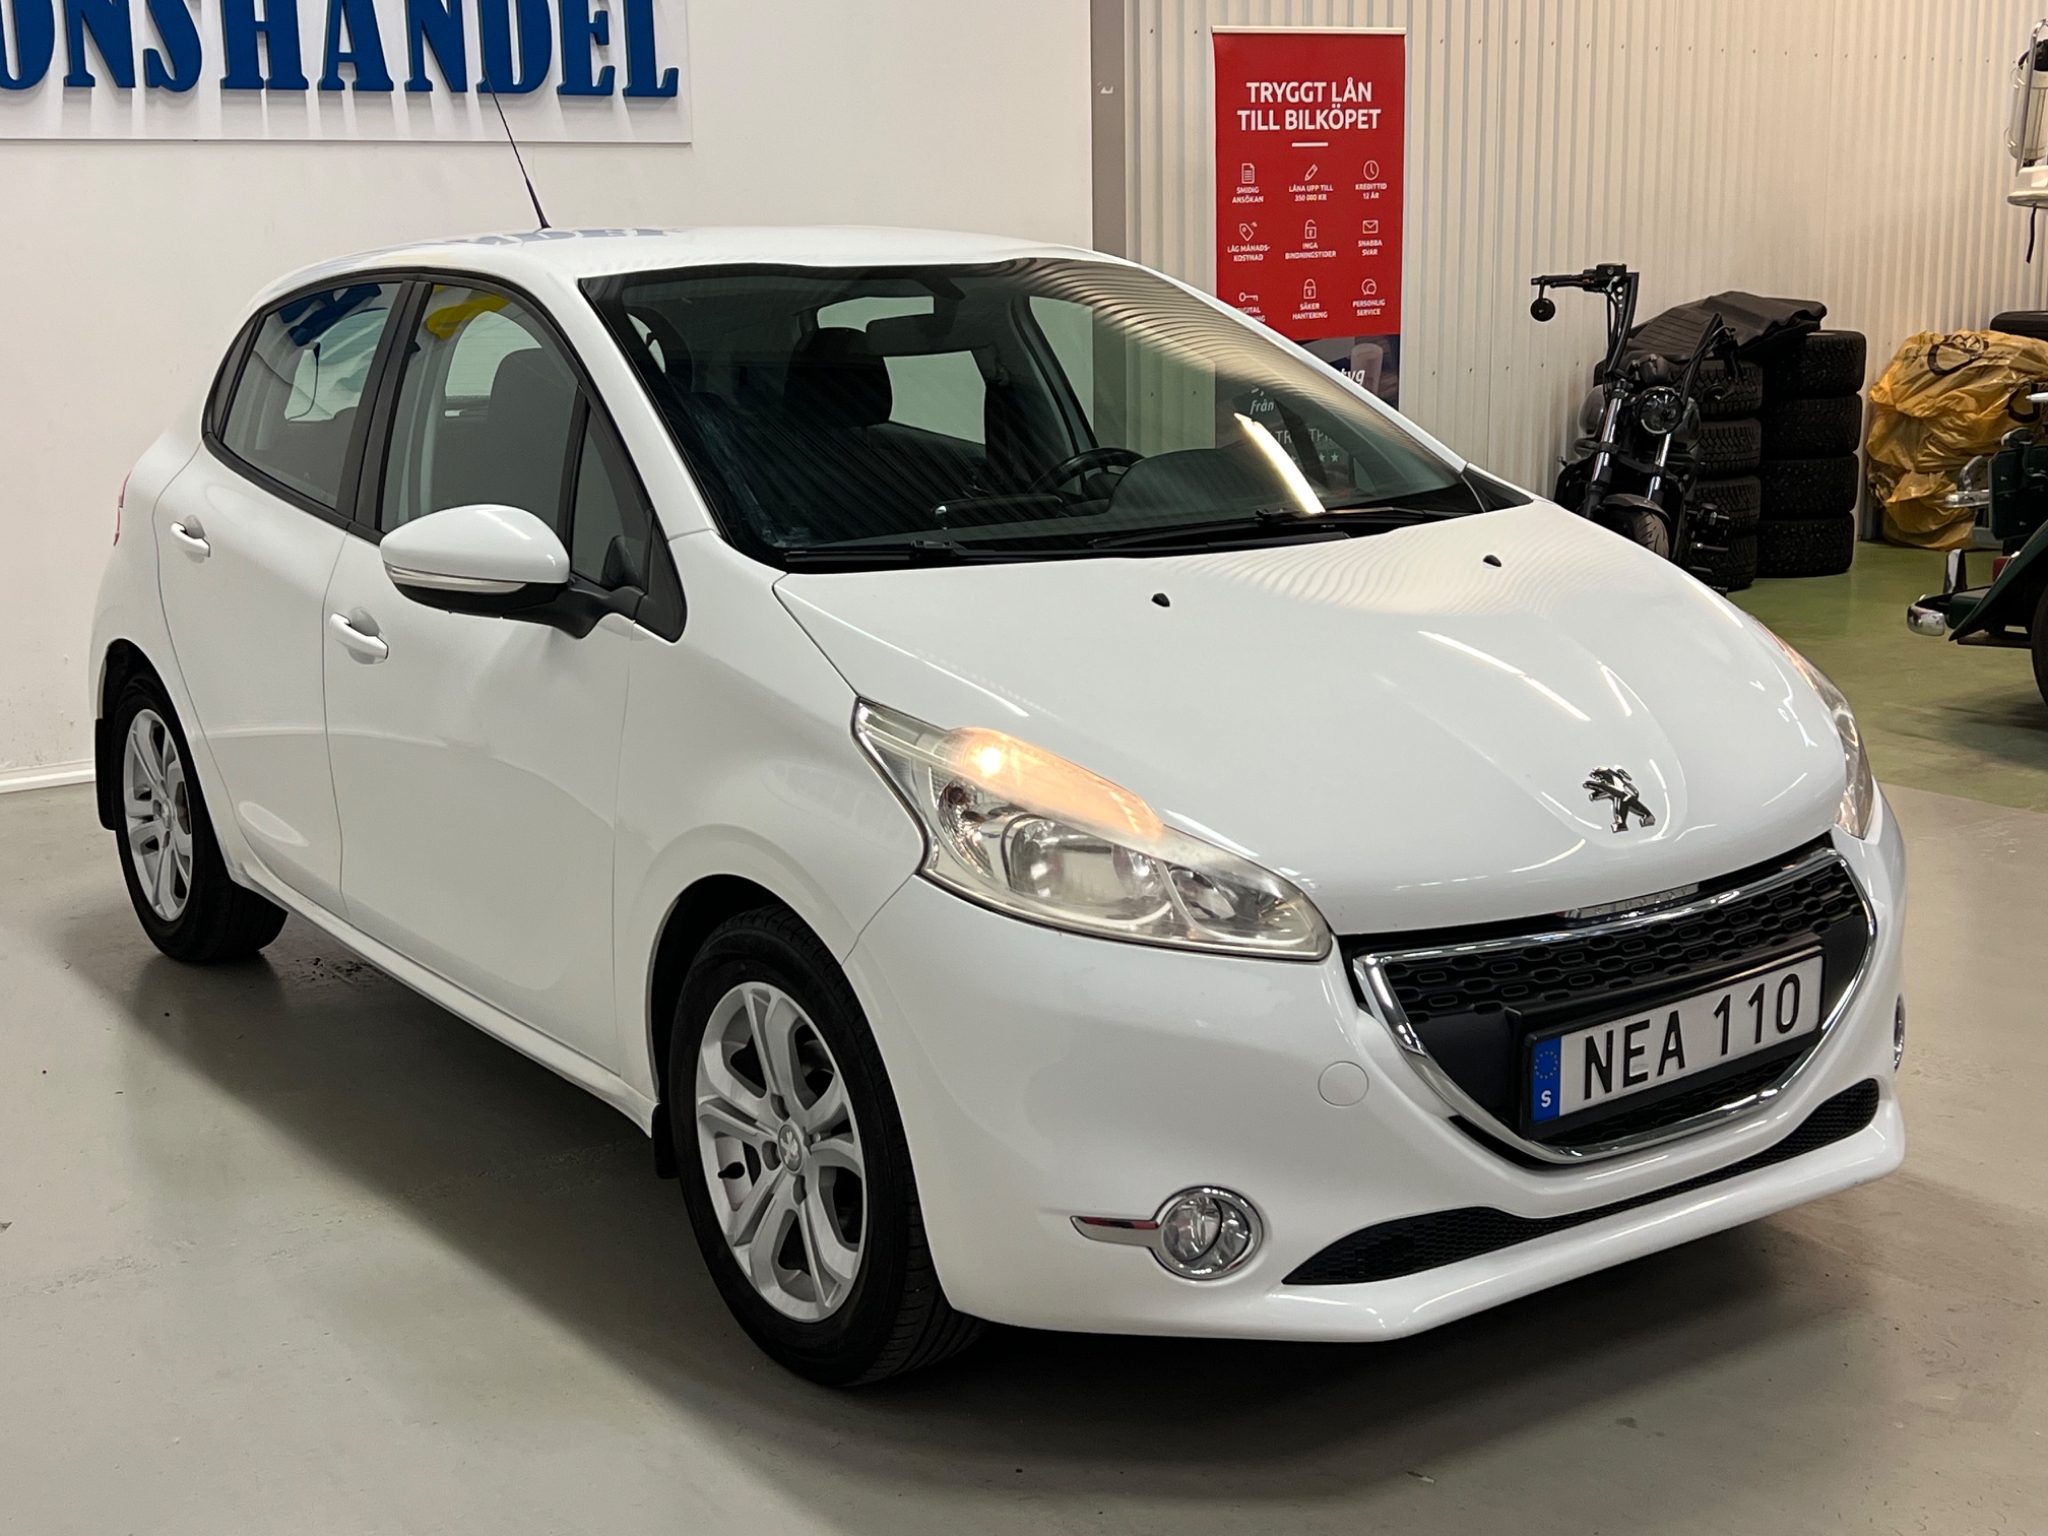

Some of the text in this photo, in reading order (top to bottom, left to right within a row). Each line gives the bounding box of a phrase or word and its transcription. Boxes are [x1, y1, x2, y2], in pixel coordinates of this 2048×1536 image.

[1246, 77, 1372, 103] TRYGGT LÅN
[1237, 103, 1382, 131] TILL BILKÖPET
[1236, 186, 1260, 194] SMIDIG
[1288, 184, 1334, 193] LÅNA UPP TILL
[1355, 182, 1388, 191] KREDITTID
[1232, 194, 1264, 203] ANSÖKAN
[1306, 194, 1318, 202] 000
[1362, 191, 1380, 200] 12 ÅR
[1227, 243, 1271, 253] LÅG MÅNADS-
[1302, 242, 1319, 250] INGA
[1357, 240, 1383, 248] SNABBA
[1284, 250, 1337, 260] BINDNINGSTIDER
[1361, 248, 1378, 256] SVAR
[1233, 254, 1264, 262] KOSTNAD
[1300, 302, 1320, 311] SÄKER
[1352, 299, 1386, 308] PERSONLIG
[1292, 311, 1328, 320] HANTERING
[1356, 308, 1381, 317] SERVICE
[1583, 973, 1800, 1100] NEA 110
[1541, 1090, 1552, 1108] S
